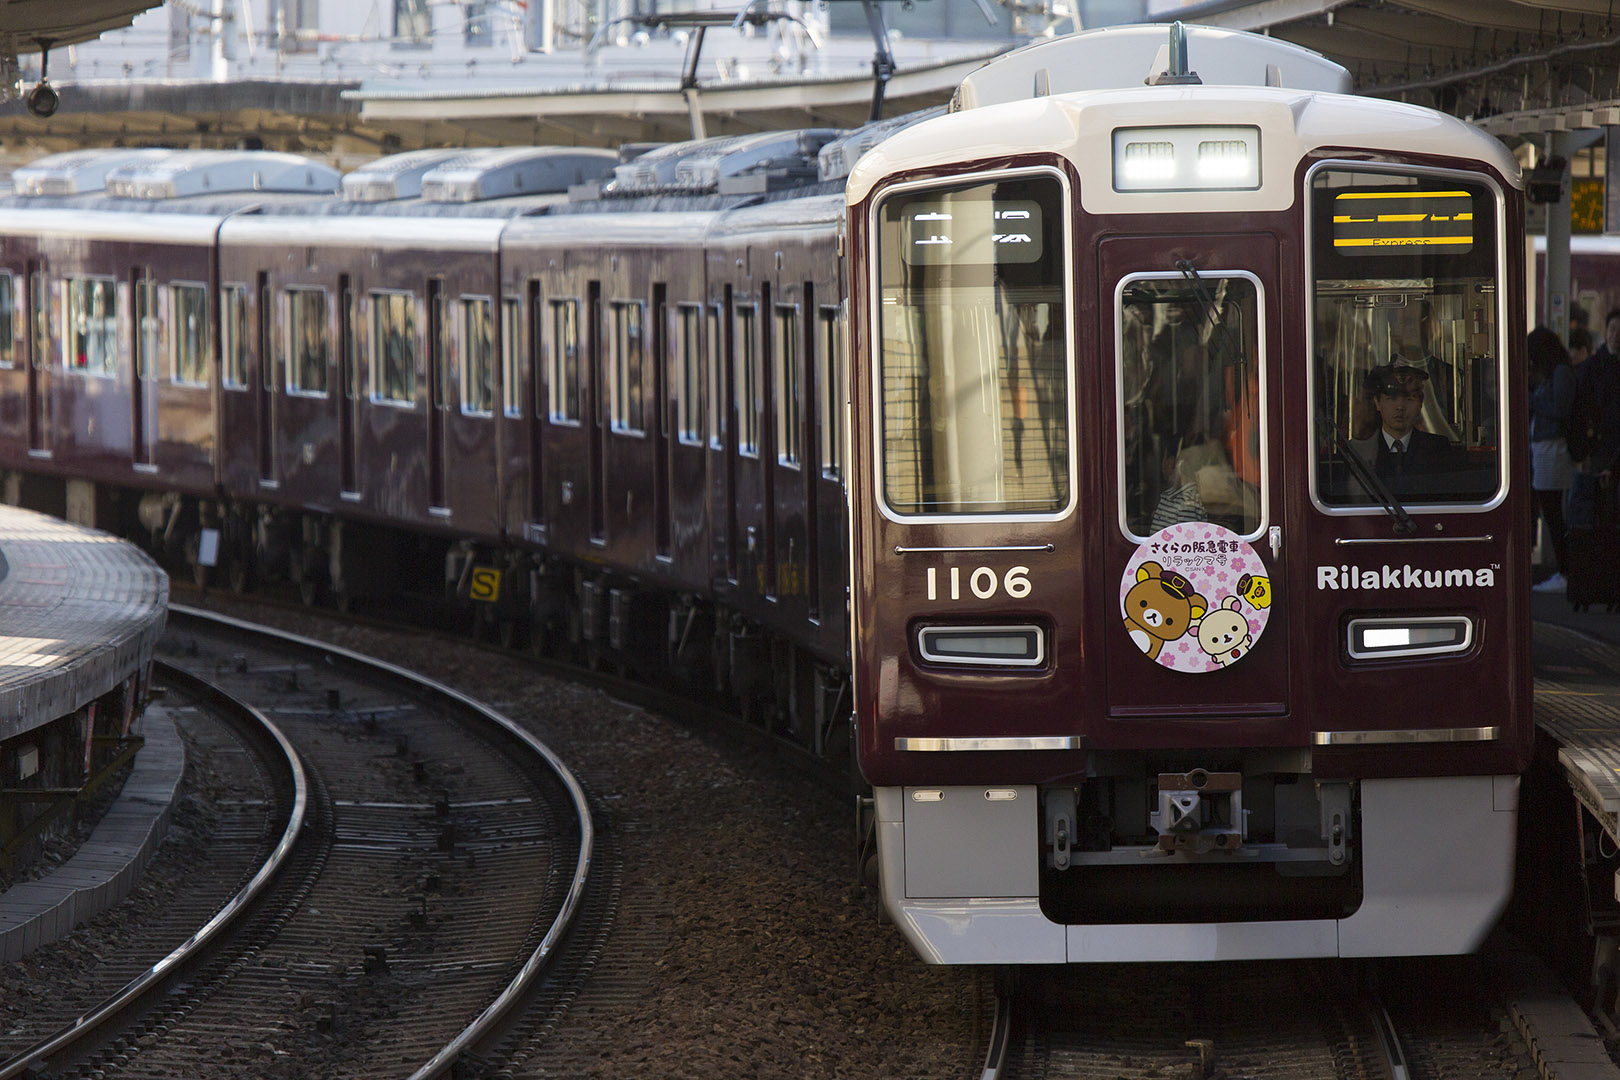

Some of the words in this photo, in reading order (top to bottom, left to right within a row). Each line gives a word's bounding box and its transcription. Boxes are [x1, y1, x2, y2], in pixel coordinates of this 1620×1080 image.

[1151, 540, 1239, 554] さくらの阪急電車
[1162, 554, 1228, 567] リラックマ号
[473, 571, 496, 598] S
[927, 566, 1032, 600] 1106
[1317, 564, 1495, 590] Rilakkuma
